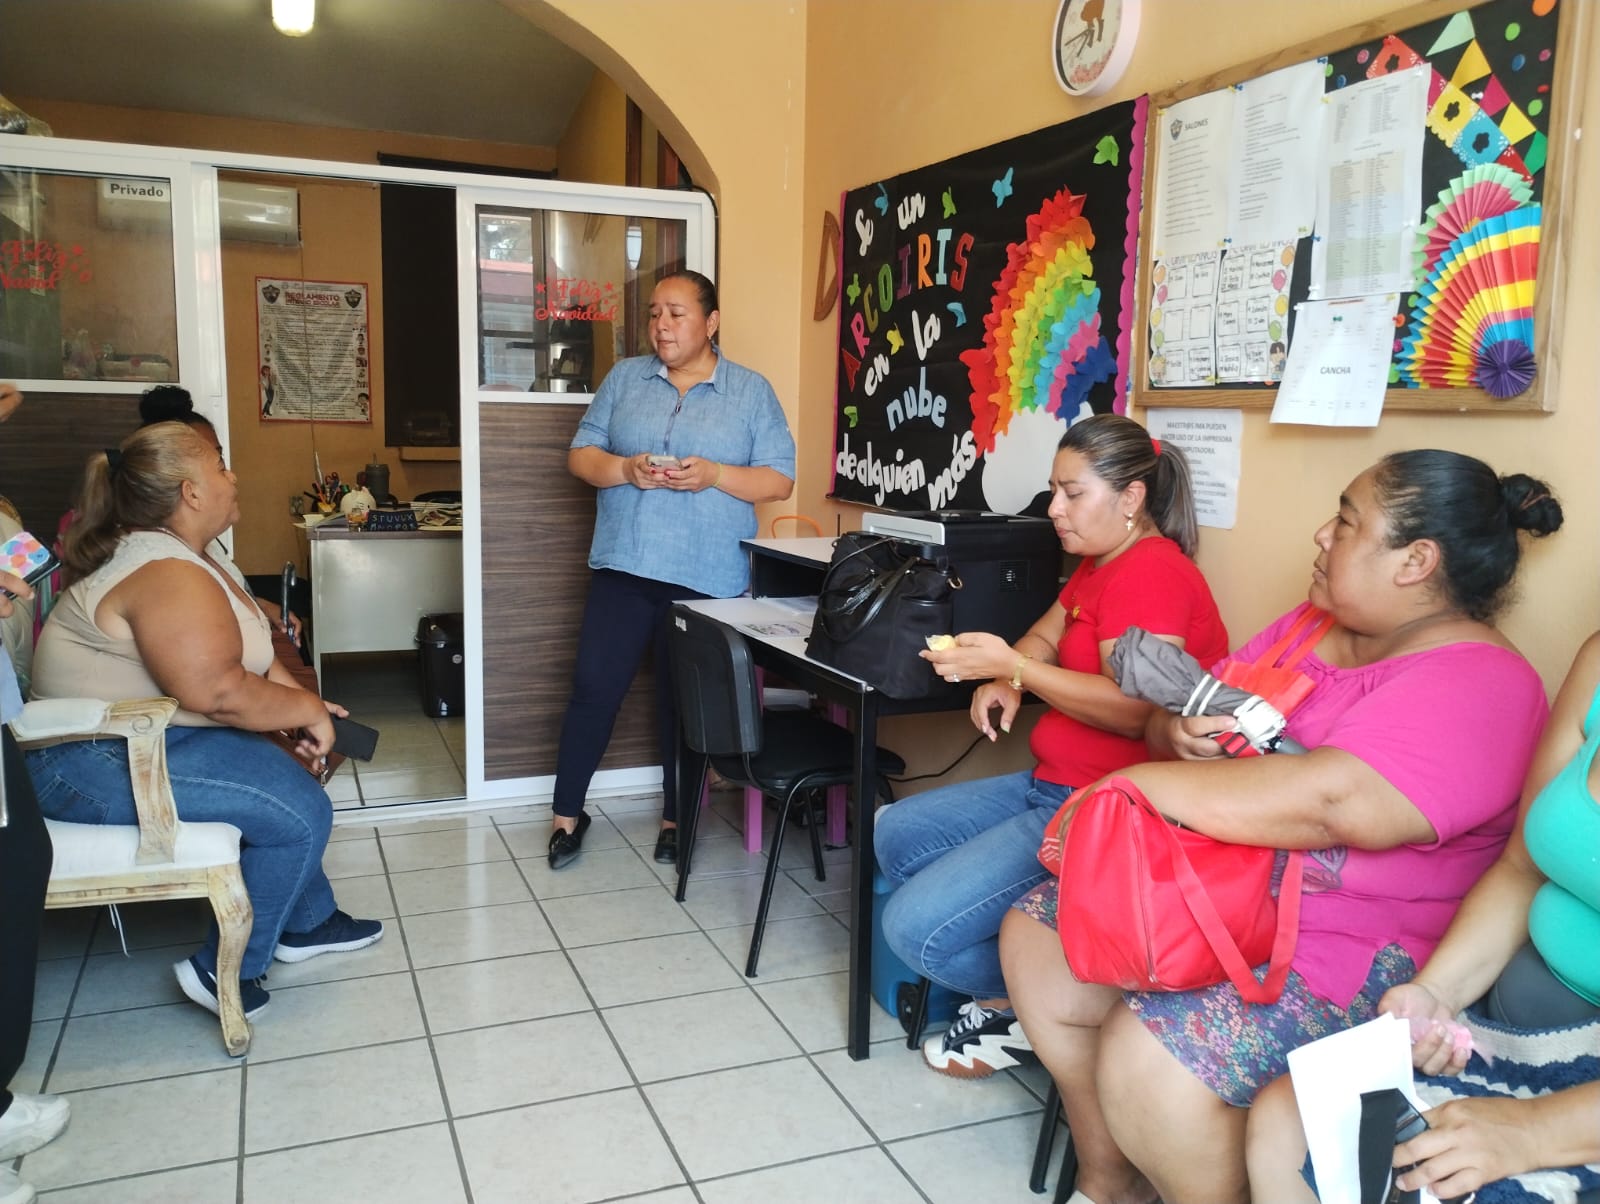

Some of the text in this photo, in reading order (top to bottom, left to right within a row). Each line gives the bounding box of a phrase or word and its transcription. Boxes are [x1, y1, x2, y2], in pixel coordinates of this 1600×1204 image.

[110, 183, 164, 197] Privado
[897, 192, 925, 230] un
[546, 277, 602, 304] Feliz
[535, 300, 619, 321] Navidad
[842, 228, 975, 392] ARCOIRIS
[865, 310, 941, 396] en la
[1320, 366, 1351, 375] CANCHA
[886, 366, 947, 432] nube
